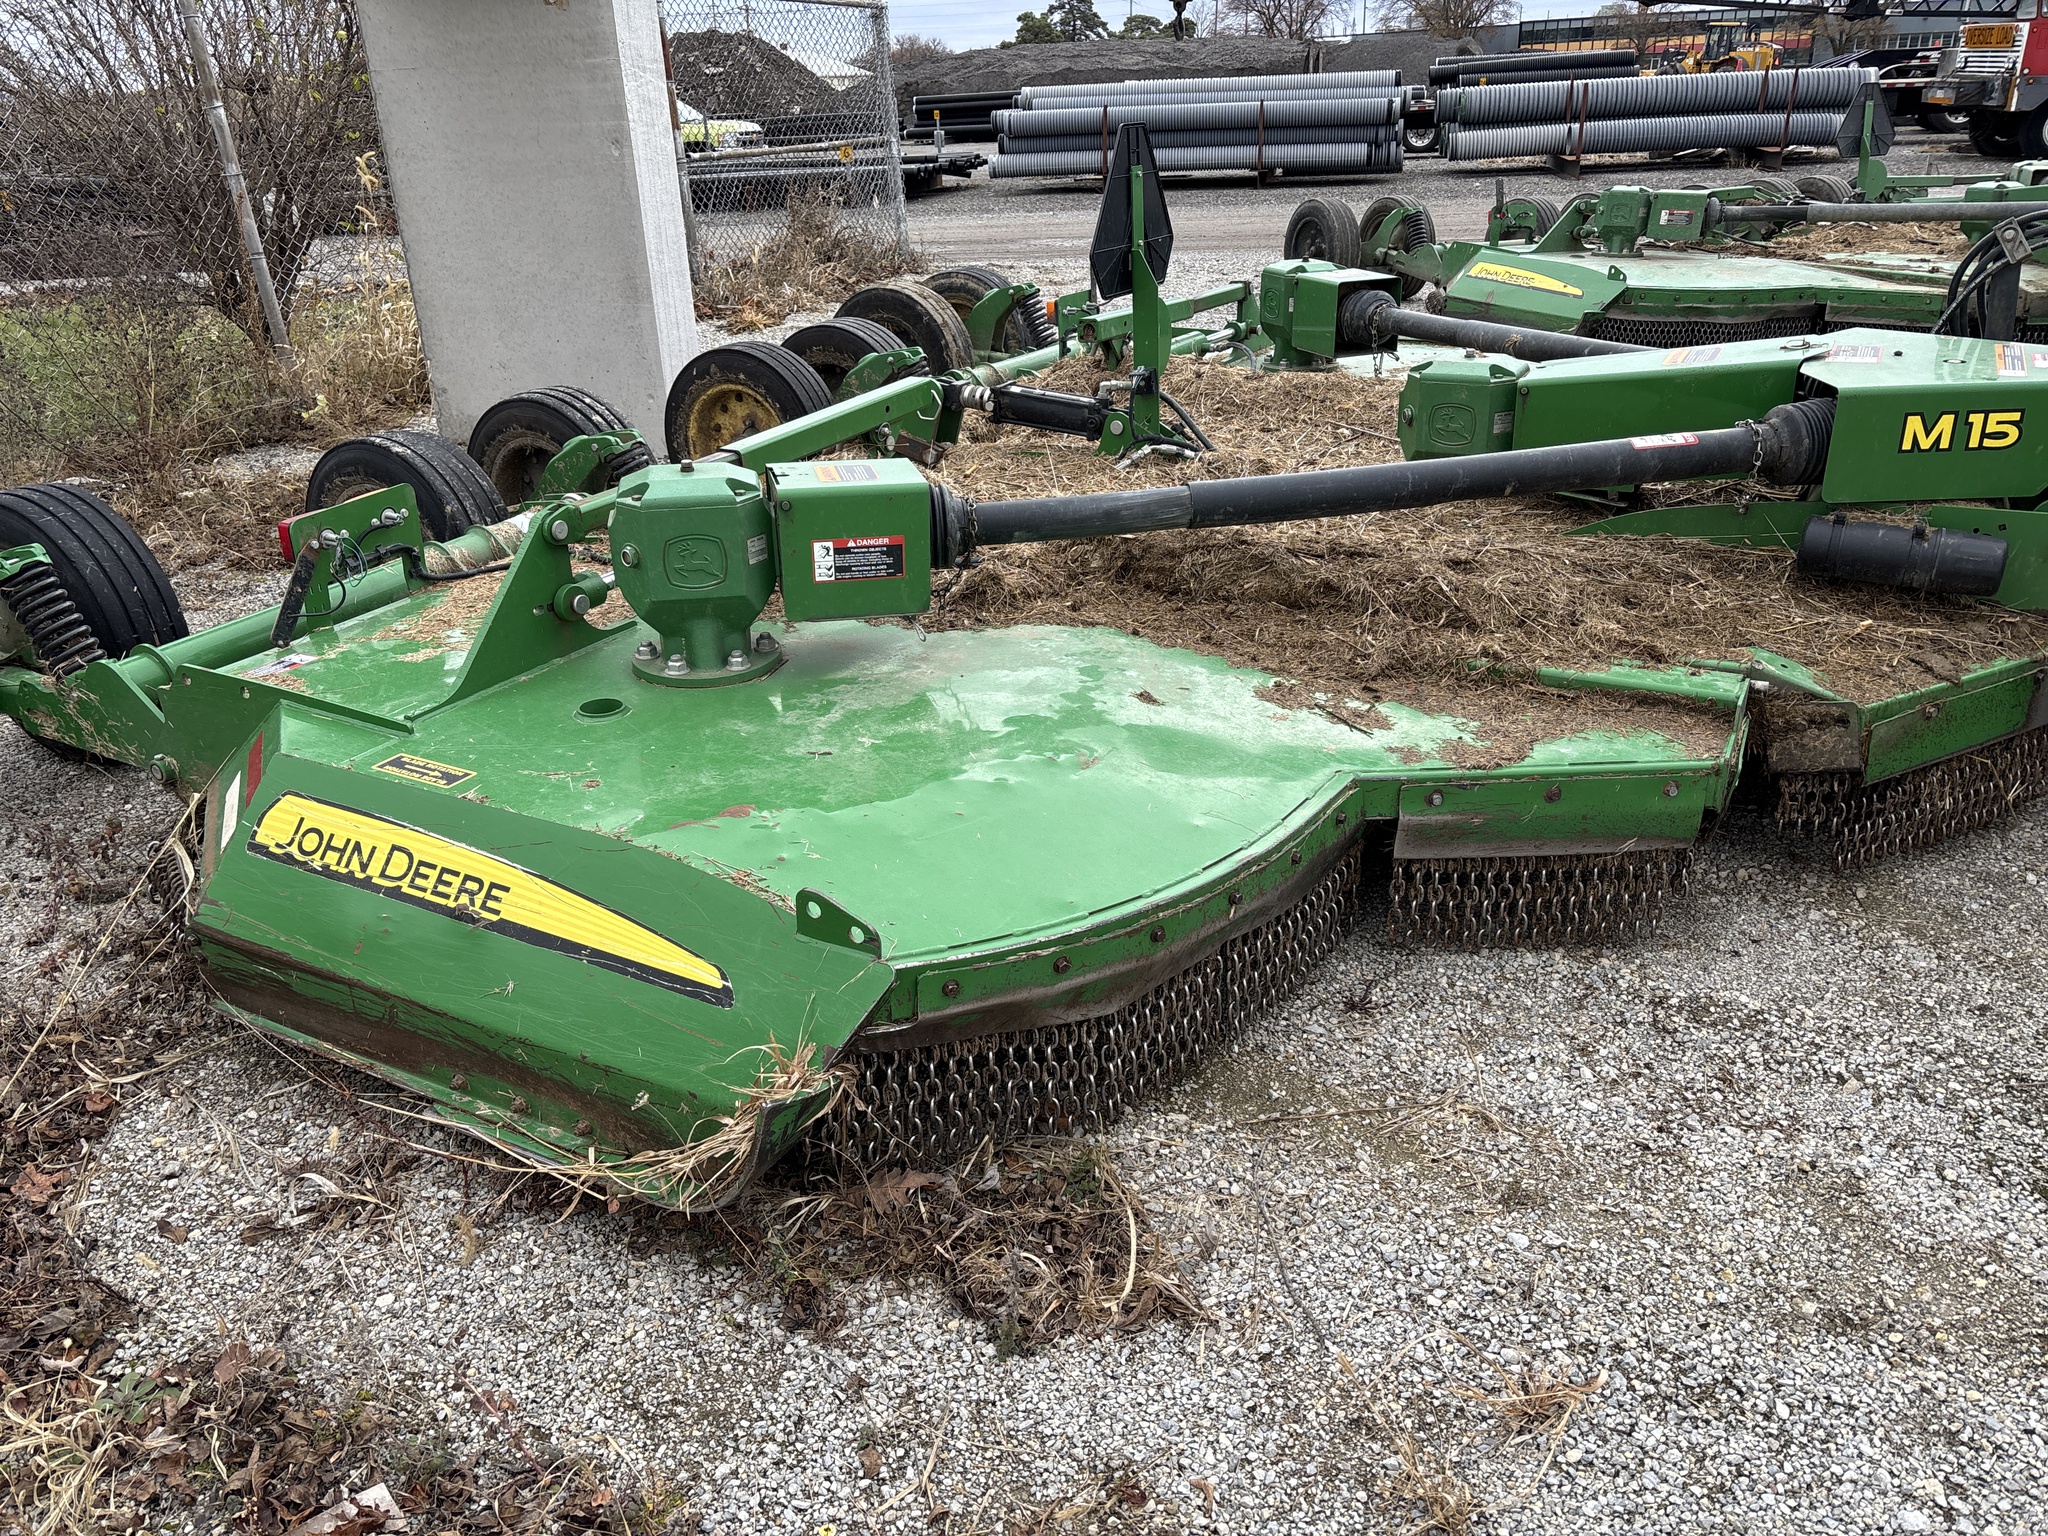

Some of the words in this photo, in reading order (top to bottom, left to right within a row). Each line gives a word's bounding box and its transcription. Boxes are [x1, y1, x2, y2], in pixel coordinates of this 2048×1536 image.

[1965, 27, 1995, 45] OVERSIZE
[1995, 26, 2013, 45] LOAD
[1477, 266, 1501, 278] JOHN
[1501, 270, 1536, 284] DEERE
[1900, 412, 1957, 452] M
[1966, 410, 2024, 451] 15
[856, 538, 890, 546] DANGER
[426, 763, 466, 777] ROTATION
[274, 816, 378, 875] JOHN
[381, 843, 512, 917] DEERE
